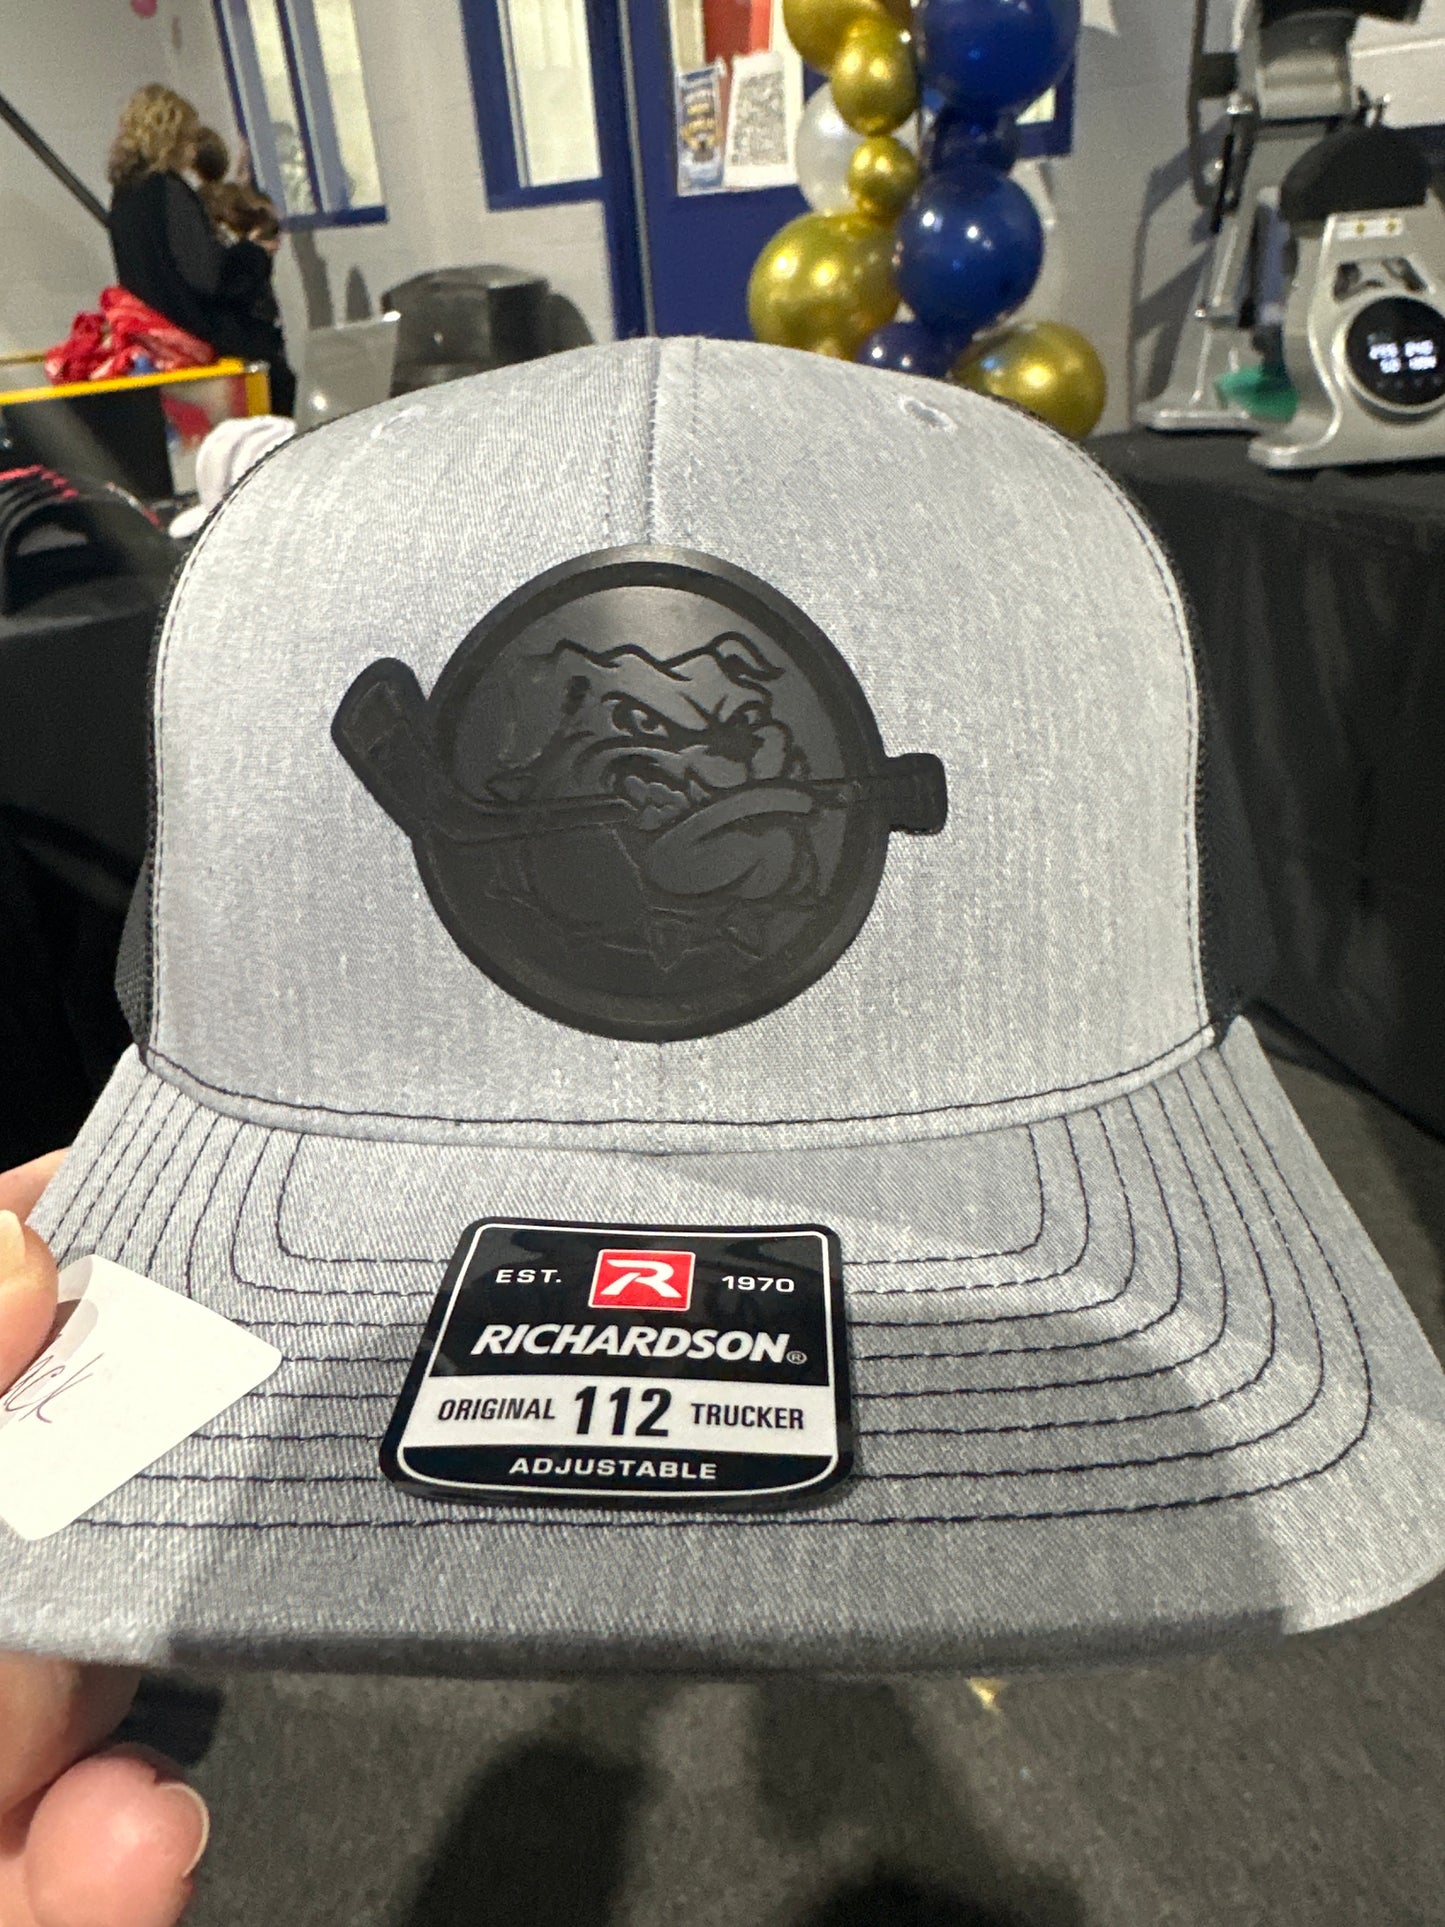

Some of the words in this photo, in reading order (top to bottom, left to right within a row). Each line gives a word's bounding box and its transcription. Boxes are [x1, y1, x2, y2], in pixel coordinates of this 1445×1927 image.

[495, 1268, 562, 1285] EST.
[721, 1275, 796, 1294] 1970
[437, 1397, 556, 1422] ORIGINAL
[574, 1385, 672, 1438] 112
[690, 1402, 805, 1430] TRUCKER
[508, 1456, 718, 1480] ADJUSTABLE
